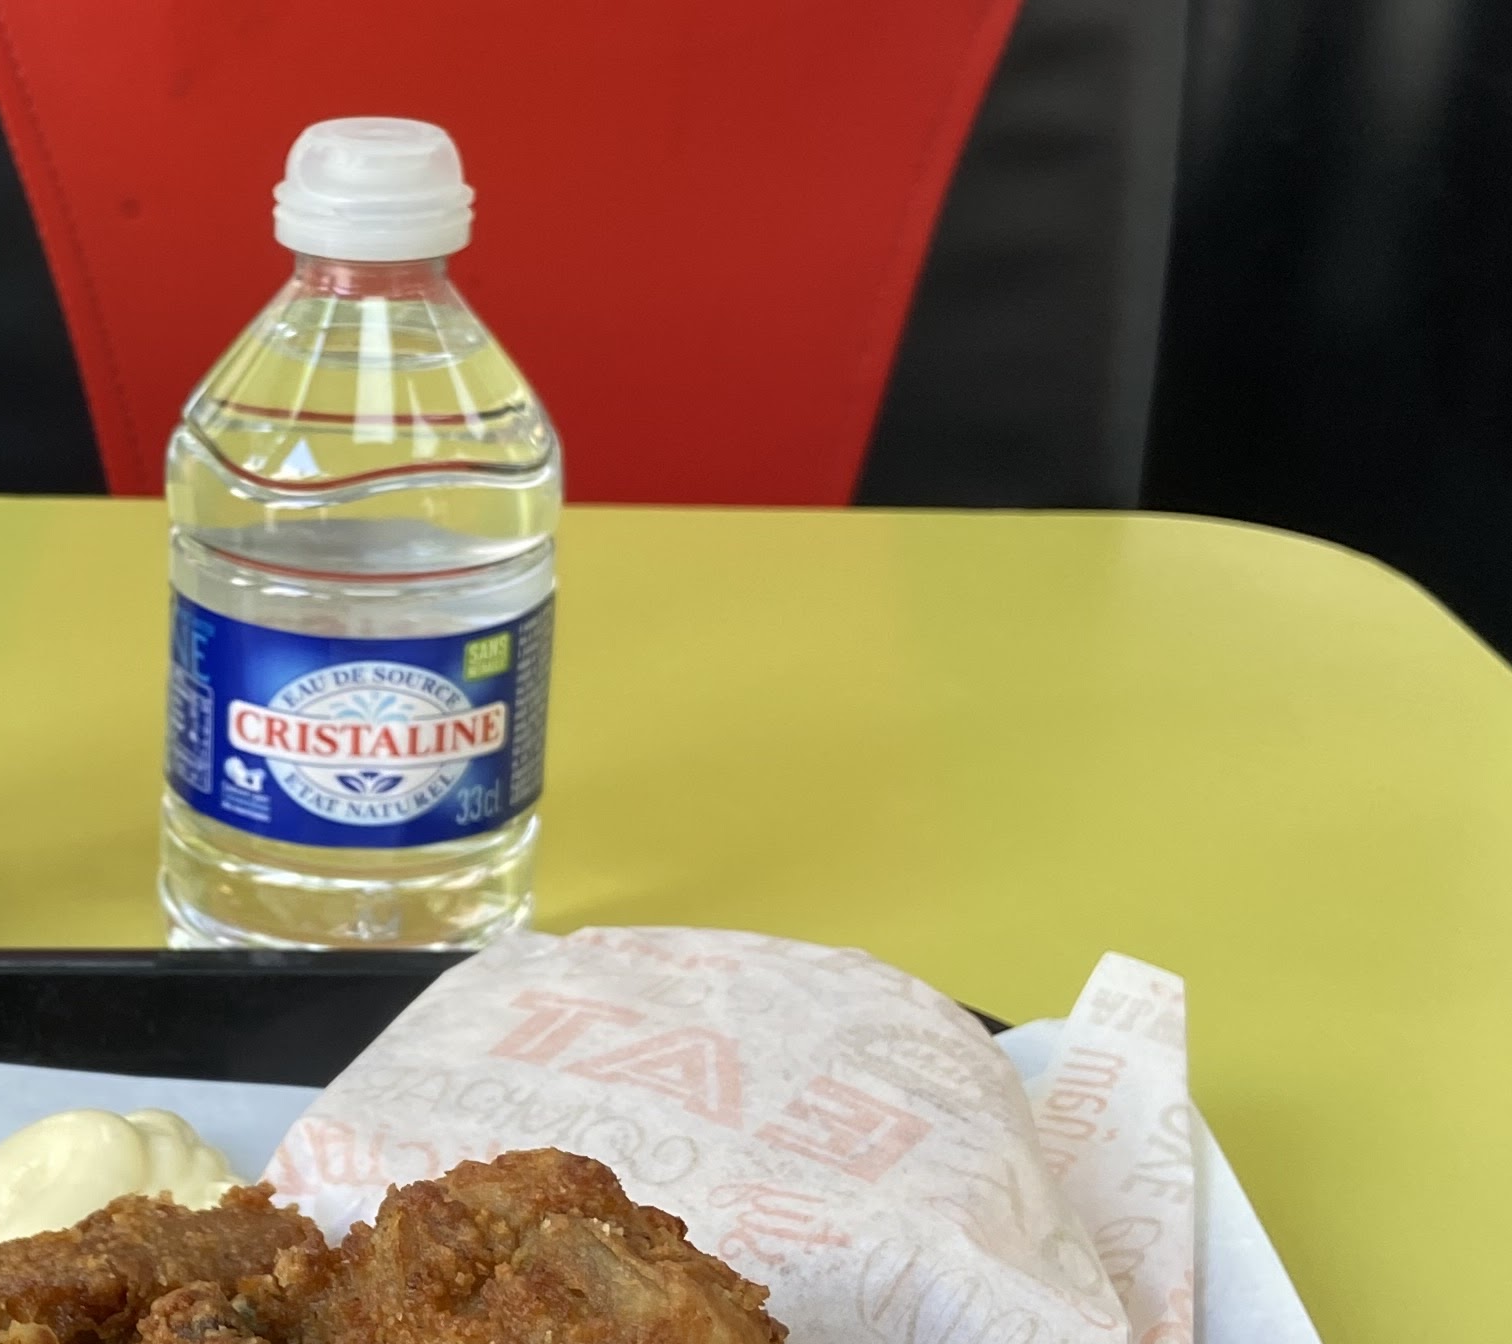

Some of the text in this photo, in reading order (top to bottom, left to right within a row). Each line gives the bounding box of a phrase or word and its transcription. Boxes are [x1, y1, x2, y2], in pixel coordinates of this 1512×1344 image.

[282, 675, 326, 708] EAU
[333, 668, 364, 686] DE
[372, 667, 461, 707] SOURCE
[233, 708, 500, 758] CRISTALINE
[346, 773, 455, 819] NATUREL
